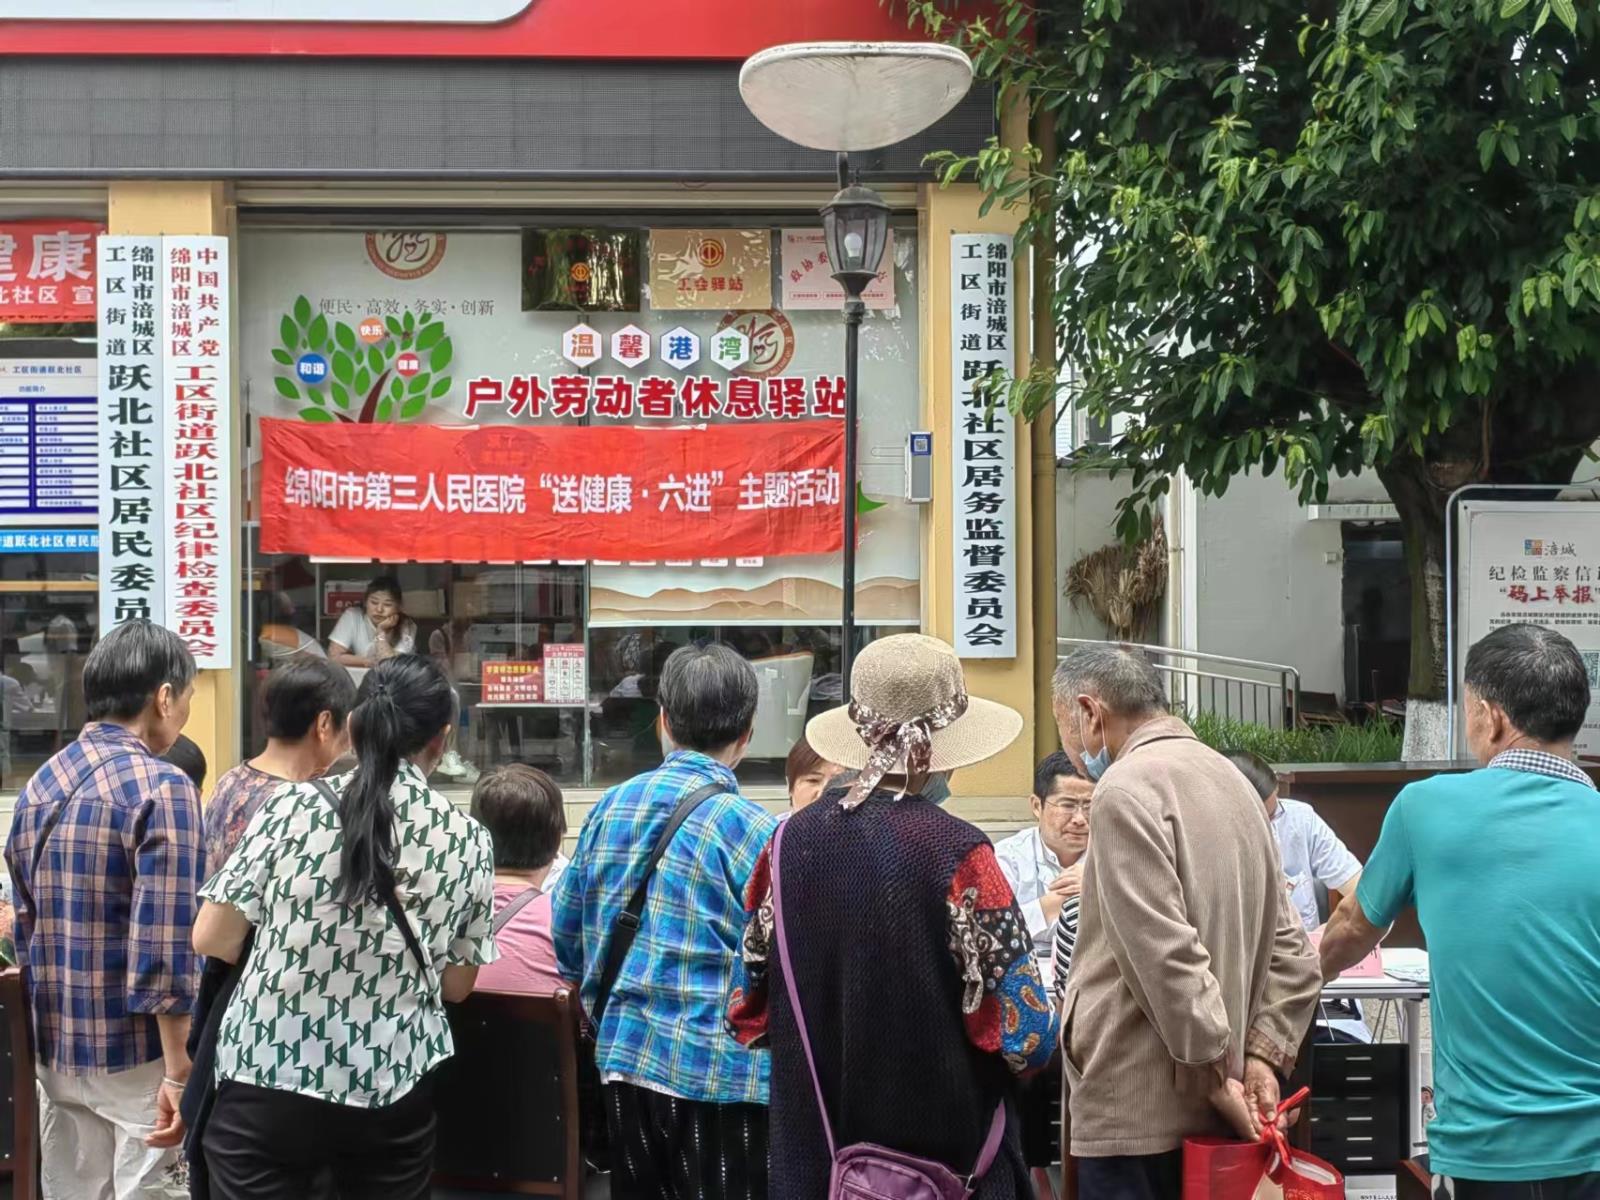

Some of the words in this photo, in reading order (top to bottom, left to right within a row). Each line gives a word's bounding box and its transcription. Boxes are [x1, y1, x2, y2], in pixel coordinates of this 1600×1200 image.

[0, 231, 92, 282] 康
[106, 246, 127, 356] 工区街道
[132, 246, 154, 356] 绵阳市涪城区
[170, 248, 192, 356] 绵阳市涪城区
[197, 248, 220, 357] 中国共产党
[677, 276, 743, 291] 工会驿站
[960, 243, 982, 351] 工区街道
[986, 243, 1007, 351] 绵阳市涪城区
[360, 325, 382, 336] 快乐
[571, 333, 743, 361] 温馨港湾
[299, 362, 325, 375] 和谐
[464, 375, 846, 418] 户外劳动者休息驿站
[174, 364, 219, 657] 工区街道跃北社区纪律检查委员会
[284, 466, 526, 514] 绵阳市第三人民医院
[737, 466, 841, 511] 主题活动
[1544, 541, 1577, 557] 涪城
